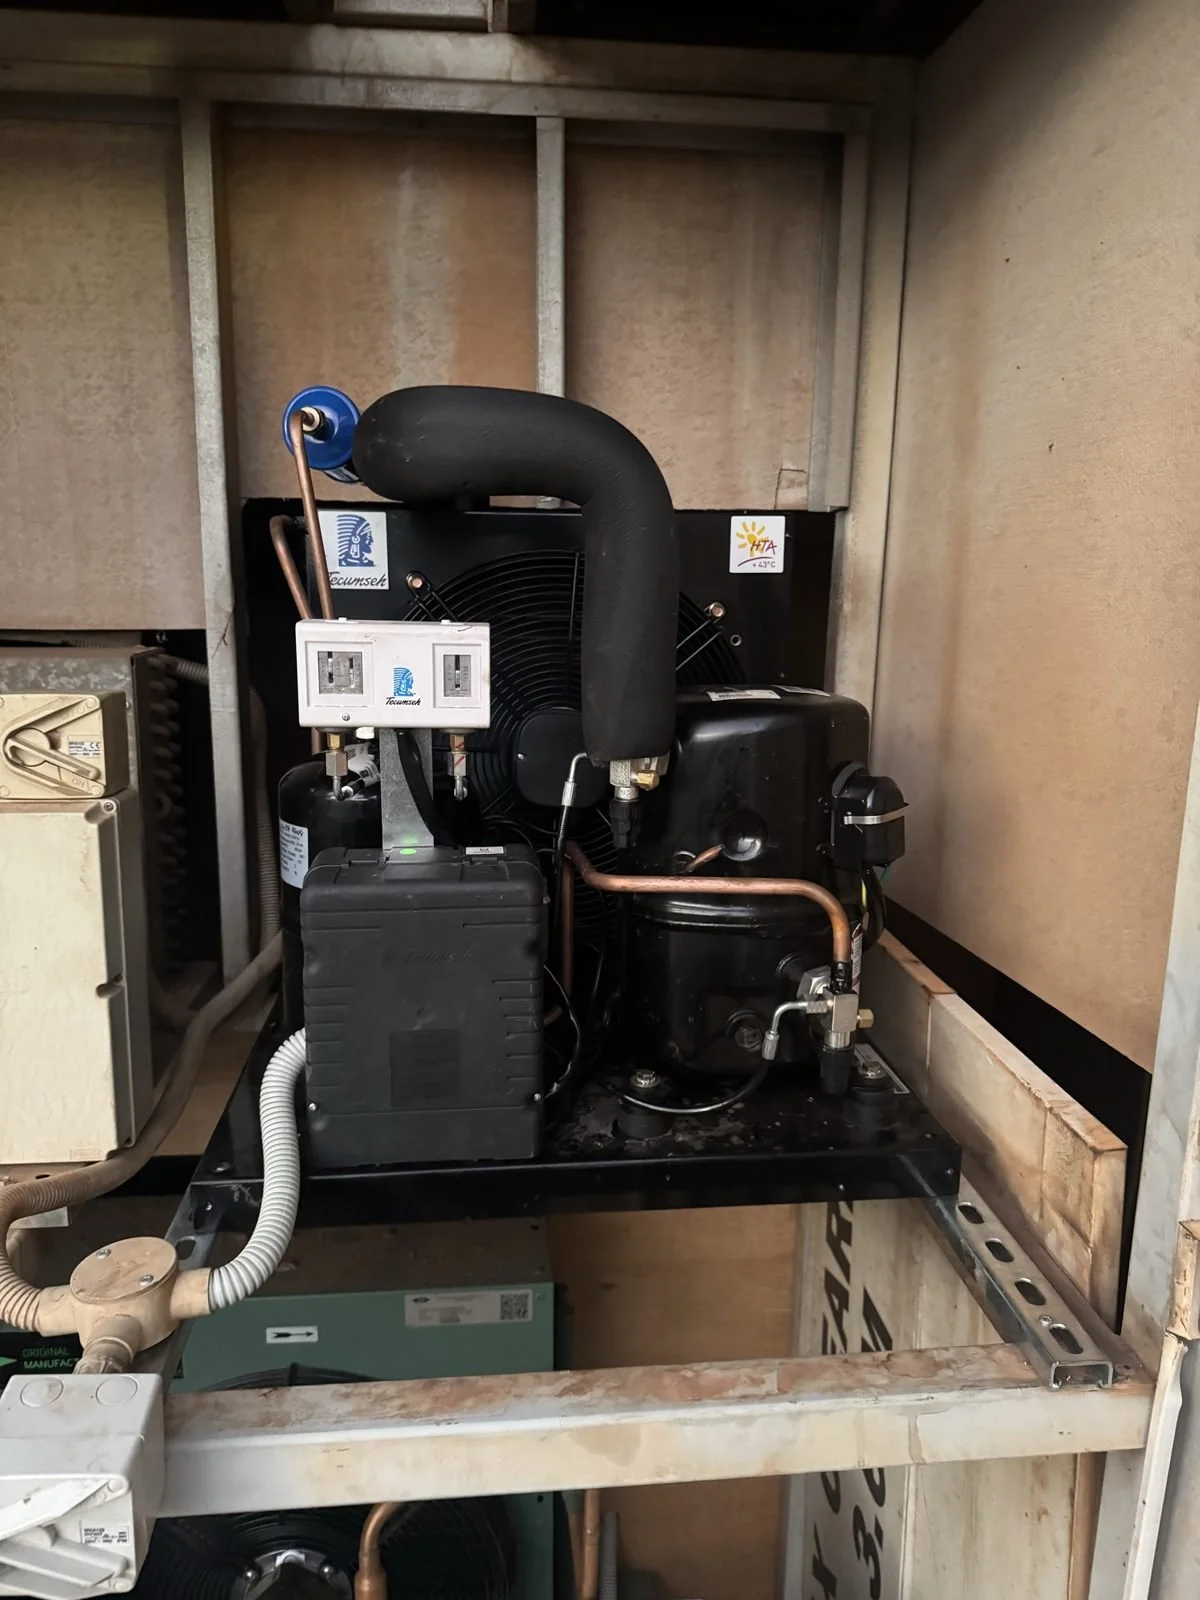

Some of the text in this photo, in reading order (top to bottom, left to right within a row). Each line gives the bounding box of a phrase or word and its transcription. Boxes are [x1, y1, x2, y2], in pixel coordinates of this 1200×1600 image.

[750, 539, 777, 555] HTA
[385, 696, 421, 706] Tecumseh
[22, 1346, 70, 1358] ORIGINAL
